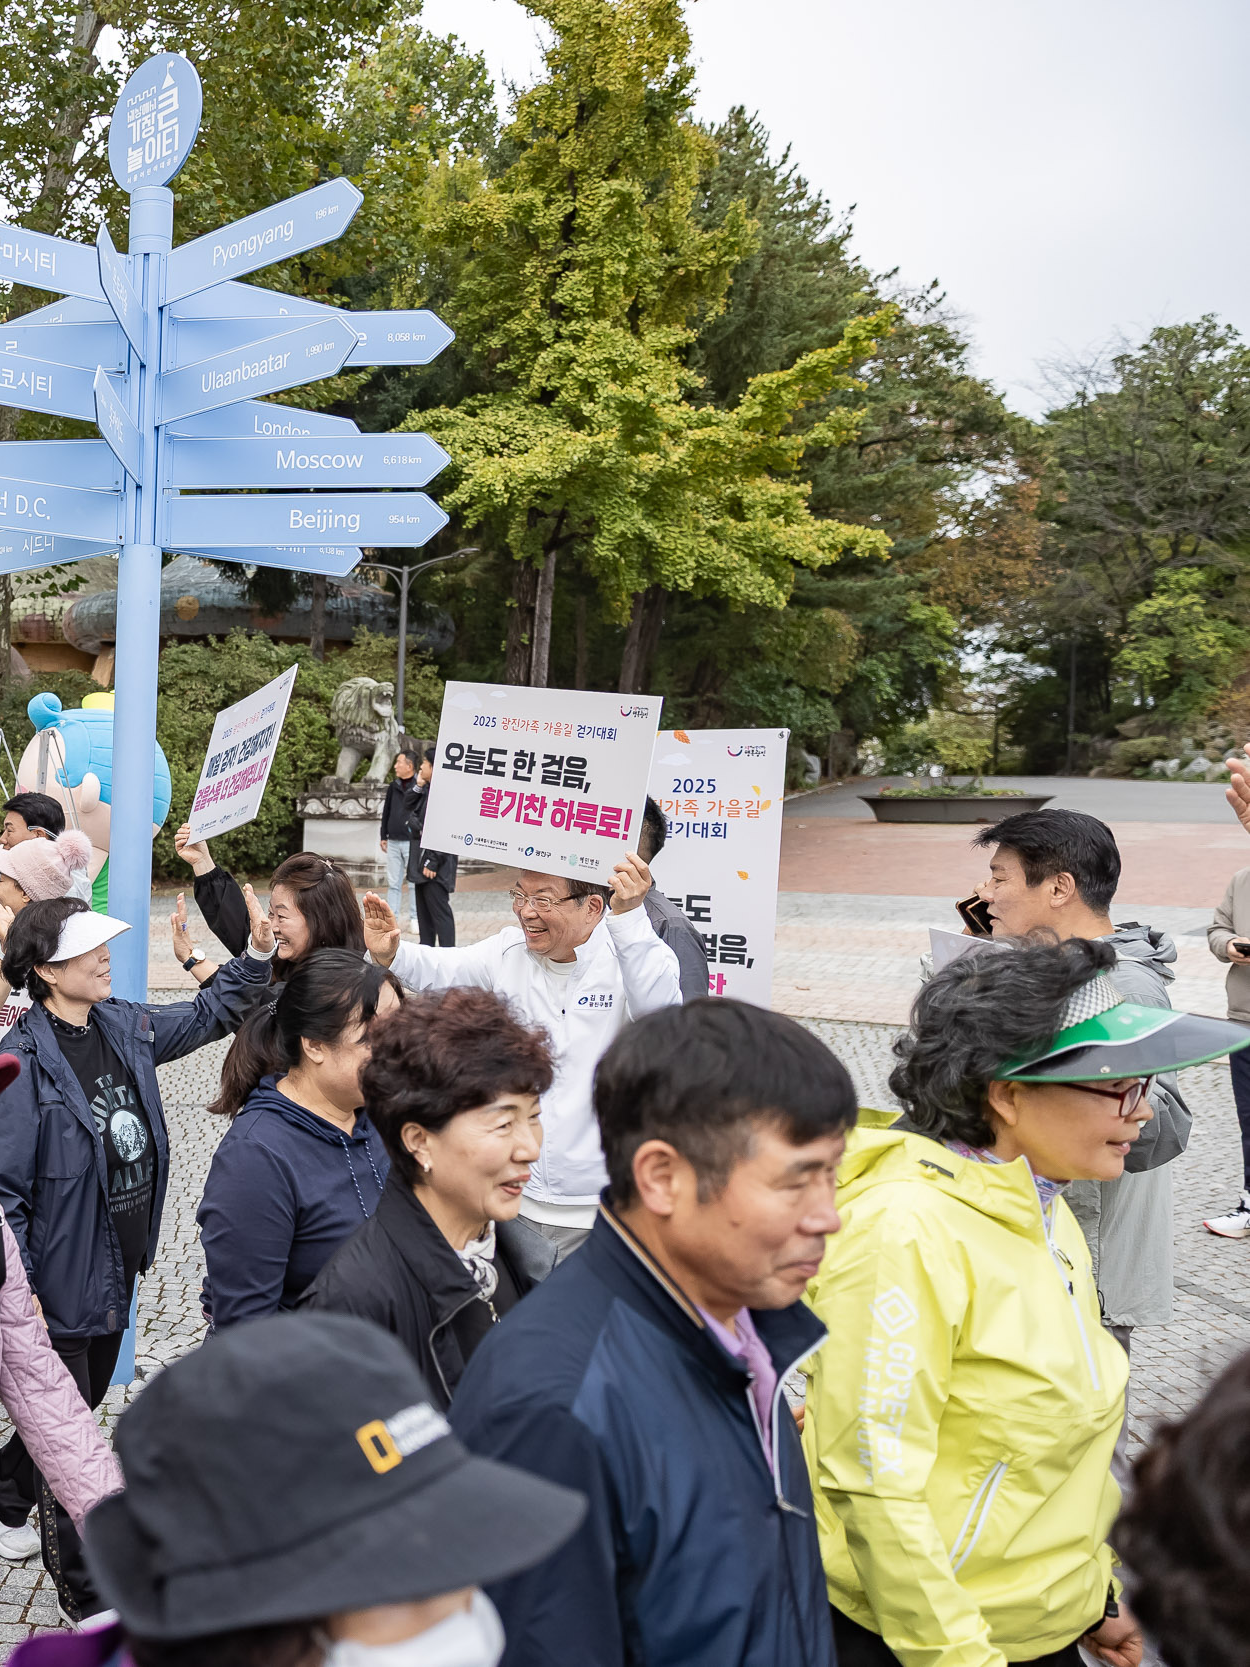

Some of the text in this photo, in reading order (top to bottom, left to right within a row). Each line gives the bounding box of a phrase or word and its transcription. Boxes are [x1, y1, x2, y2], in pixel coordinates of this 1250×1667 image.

[127, 124, 180, 174] 놀이터
[328, 204, 339, 216] km
[213, 219, 294, 266] Pyongyang
[323, 341, 335, 351] km
[387, 332, 426, 343] 8,058 km
[201, 352, 291, 393] Ulaanbaatar
[276, 450, 364, 470] Moscow
[383, 456, 422, 466] 6,618 km
[15, 494, 51, 520] D.C.
[289, 509, 361, 533] Beijing
[388, 515, 420, 524] 954 km
[22, 535, 55, 557] 시드니
[473, 715, 618, 742] 2025 광진가족 가을길 걷기대회
[442, 742, 592, 794] 오늘도 한 걸음,
[672, 778, 717, 794] 2025
[479, 786, 633, 841] 활기찬 하루로!
[707, 799, 761, 819] 가을길
[877, 1341, 916, 1477] GORE-TEX
